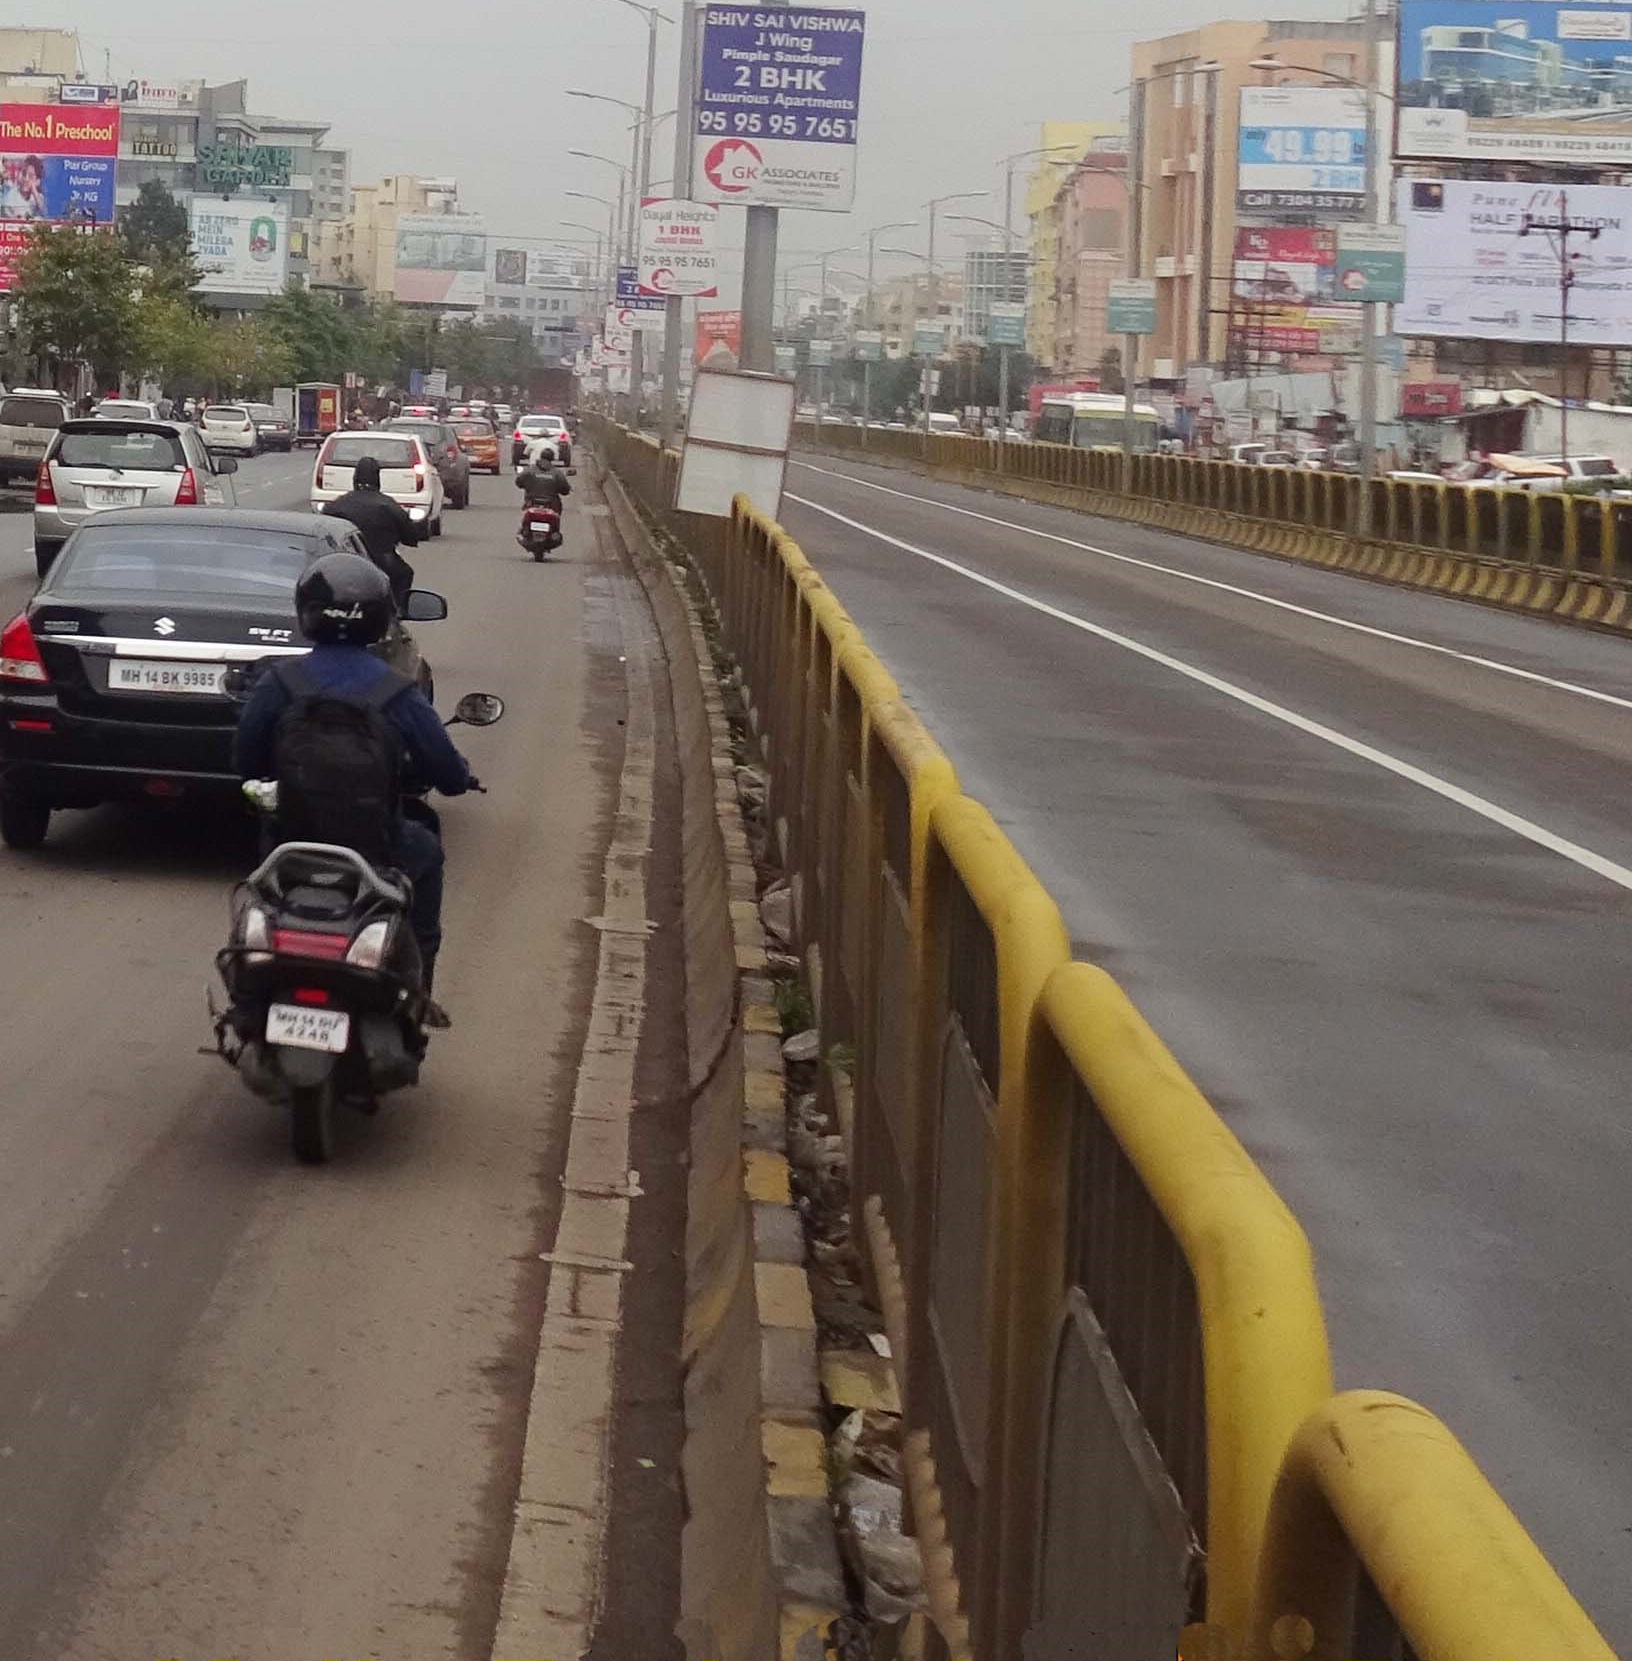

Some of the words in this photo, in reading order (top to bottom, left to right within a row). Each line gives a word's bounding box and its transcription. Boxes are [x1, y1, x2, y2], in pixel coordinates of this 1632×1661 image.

[707, 11, 750, 27] SHIV
[753, 13, 785, 29] SAI
[788, 15, 864, 33] VISHWA
[755, 32, 764, 46] J
[768, 33, 813, 51] Wing
[721, 48, 771, 62] Pimple
[774, 51, 843, 66] Saudagar
[734, 65, 751, 87] 2
[759, 67, 827, 91] BHK
[704, 88, 770, 105] Luxurious
[773, 92, 855, 110] Apartments
[0, 121, 22, 138] The
[56, 123, 113, 141] Preschool
[699, 111, 727, 131] 95
[734, 112, 762, 133] 95
[768, 114, 797, 135] 95
[805, 116, 856, 139] 7651
[134, 141, 177, 155] TATTOO
[732, 166, 758, 180] GK
[761, 167, 840, 182] ASSOCIATES
[1245, 193, 1272, 206] Call
[1470, 213, 1517, 226] HALF
[121, 668, 140, 683] MH
[144, 670, 158, 684] 14
[161, 671, 180, 686] BK
[183, 672, 215, 687] 9985
